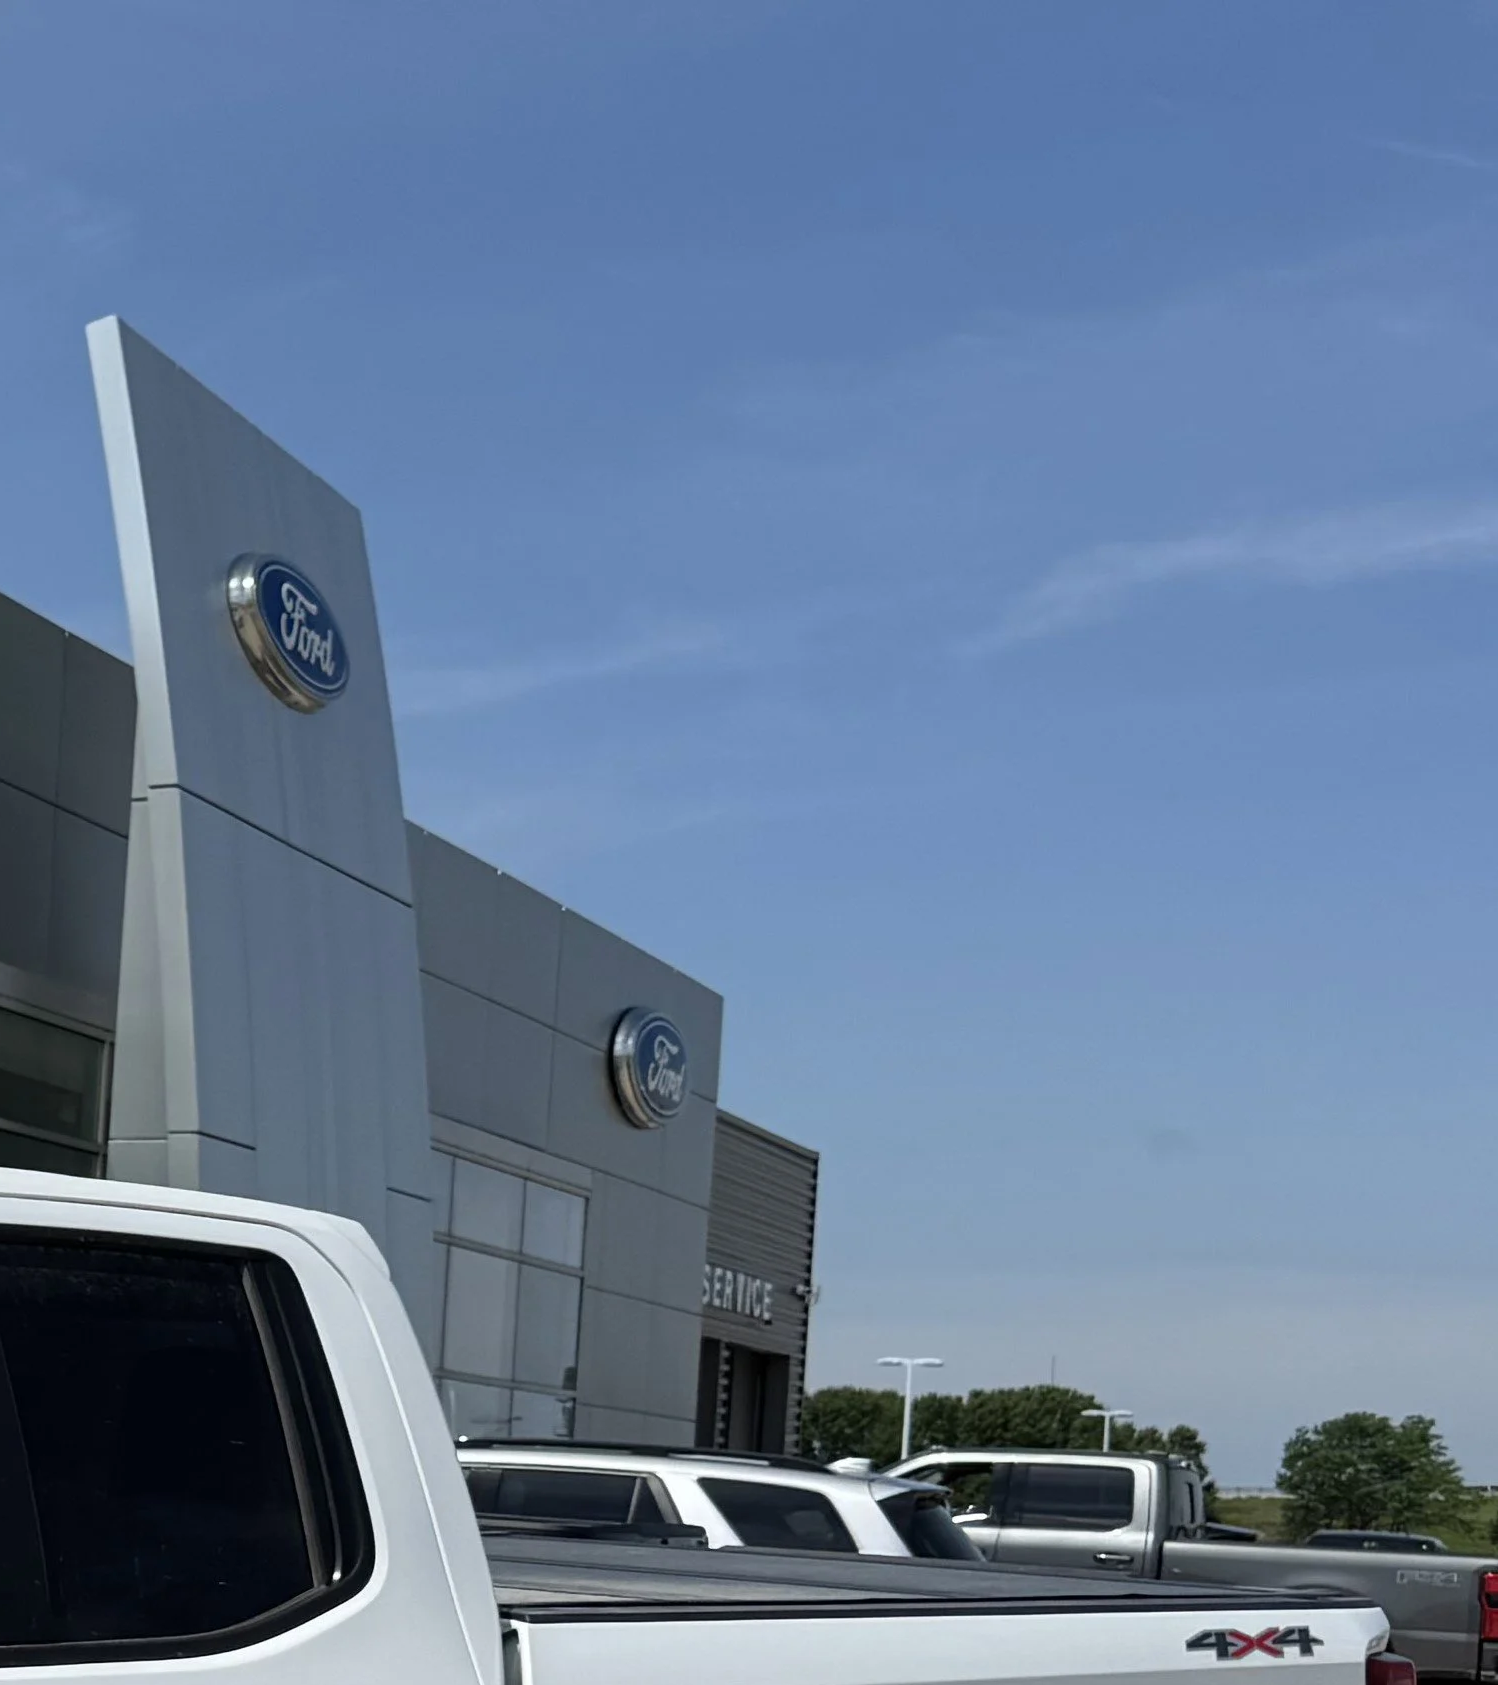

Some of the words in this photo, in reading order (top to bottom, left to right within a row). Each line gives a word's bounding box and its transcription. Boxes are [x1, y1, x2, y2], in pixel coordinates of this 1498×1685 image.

[280, 581, 336, 677] Ford
[648, 1035, 685, 1102] Ford
[702, 1264, 773, 1320] SERVICE
